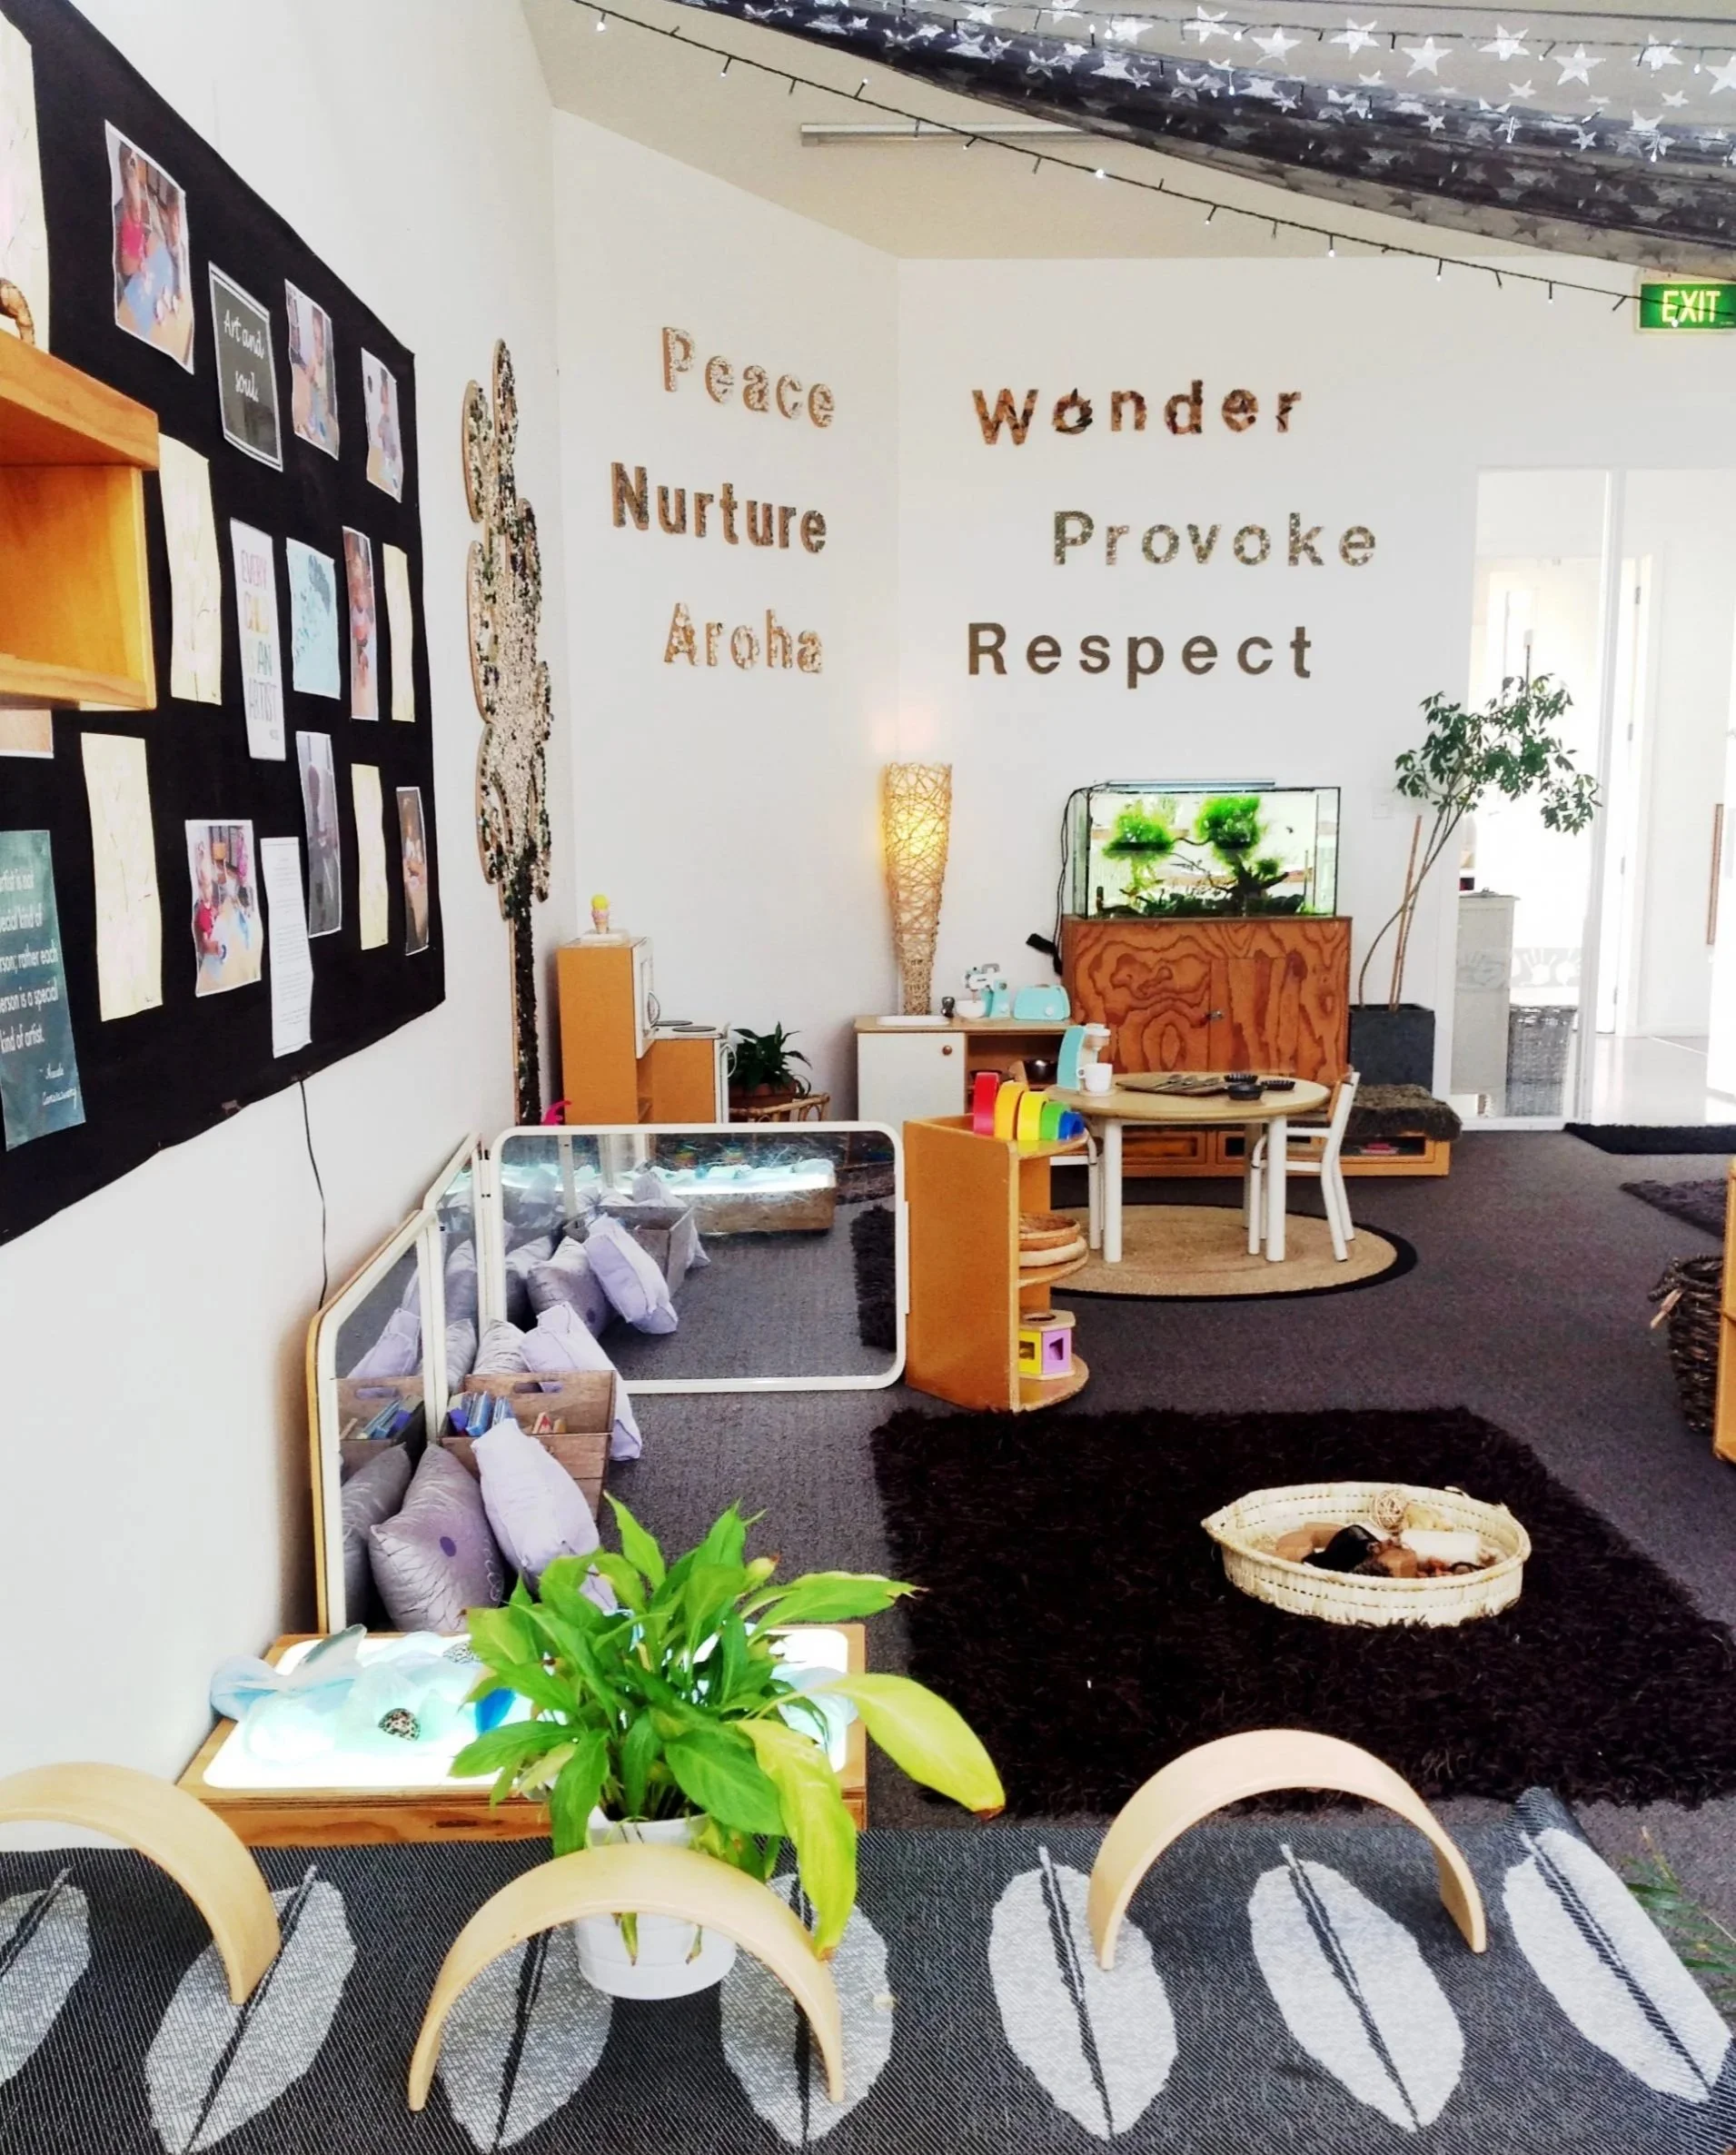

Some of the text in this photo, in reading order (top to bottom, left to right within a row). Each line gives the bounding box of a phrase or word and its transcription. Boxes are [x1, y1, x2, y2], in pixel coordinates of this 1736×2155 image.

[223, 309, 264, 360] Art and
[1662, 290, 1721, 323] EXIT
[662, 326, 836, 429] Peace
[972, 379, 1302, 446] Wonder
[610, 462, 827, 553] Nurture
[1053, 510, 1376, 566] Provoke
[664, 602, 823, 673] Aroha
[968, 622, 1312, 690] Respect
[0, 988, 20, 1015] erson
[35, 977, 58, 1011] special
[16, 1024, 24, 1049] of
